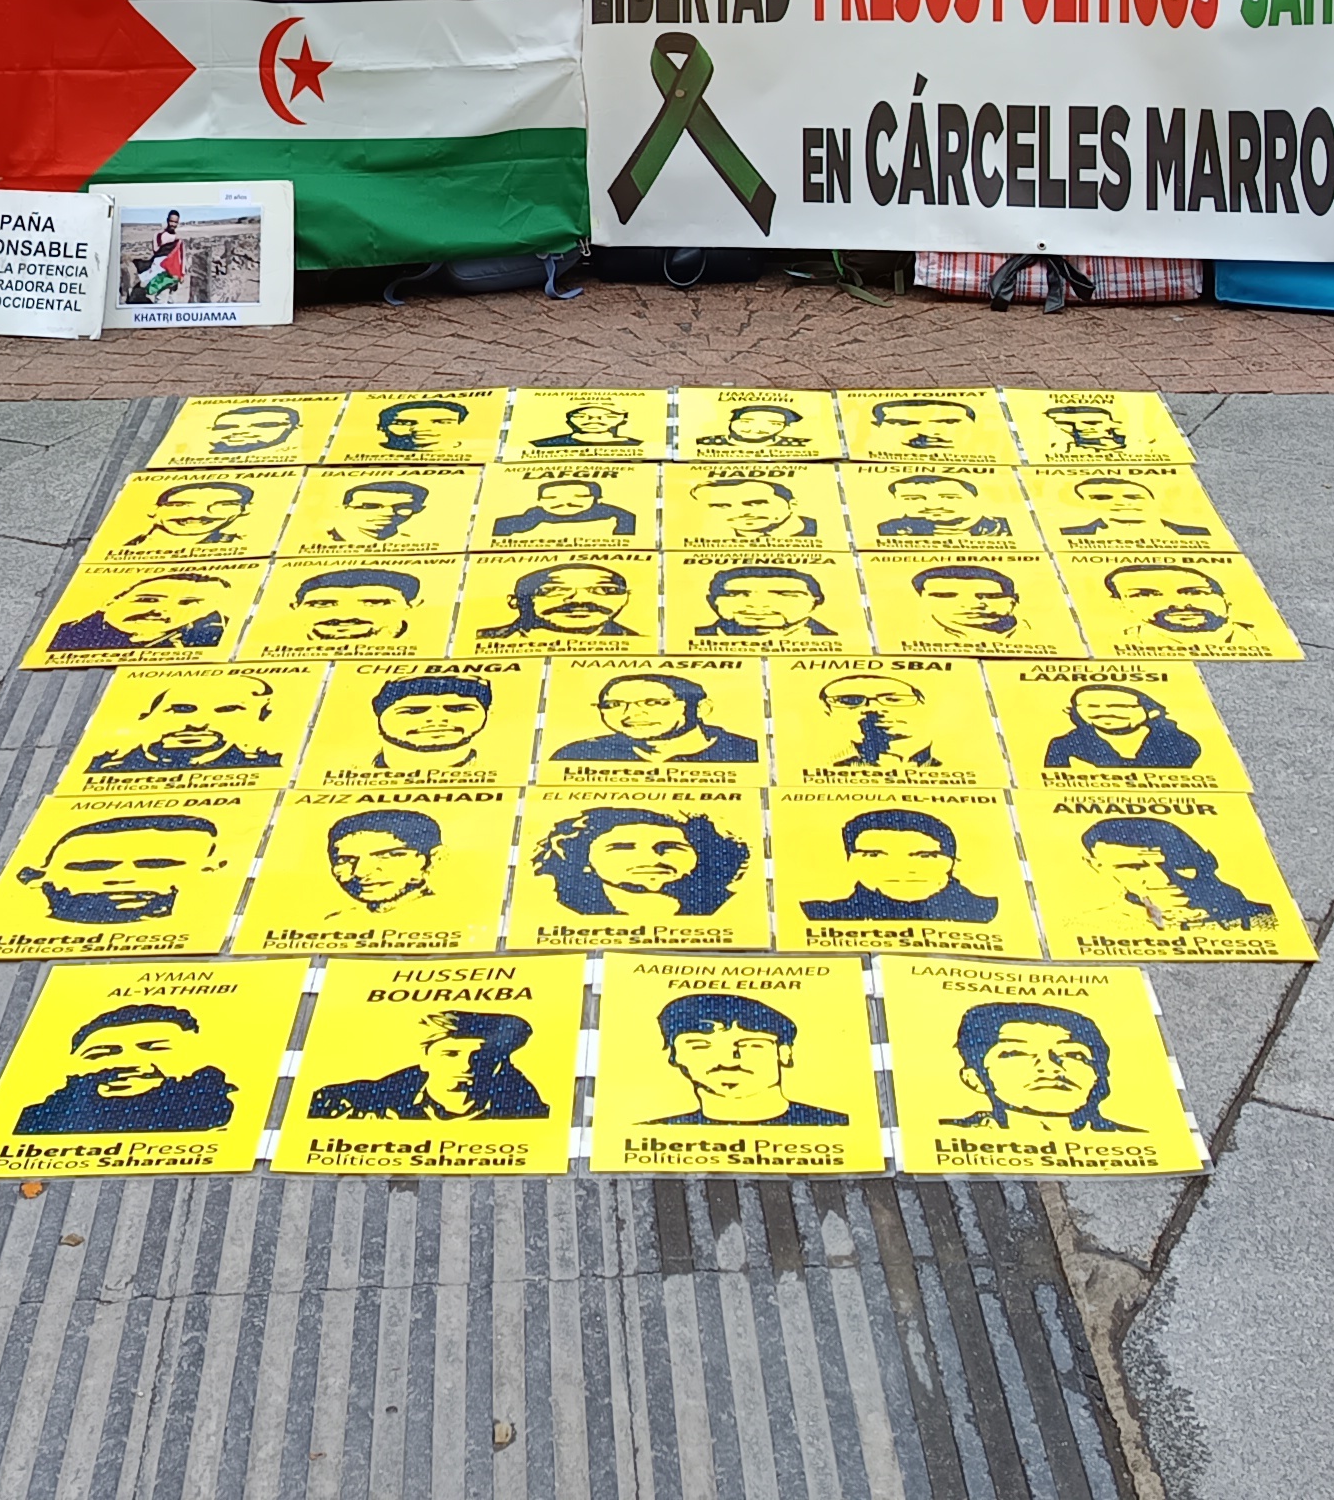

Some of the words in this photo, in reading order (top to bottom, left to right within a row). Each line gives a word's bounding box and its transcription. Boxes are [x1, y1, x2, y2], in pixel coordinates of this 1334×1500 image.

[803, 128, 851, 204] EN
[867, 72, 1130, 212] CÁRCELES
[18, 263, 88, 278] POTENCIA
[59, 283, 85, 295] DEL
[133, 312, 172, 323] KHATRI
[175, 310, 237, 323] BOUJAMAA
[1035, 467, 1122, 476] HASSAN
[1127, 467, 1178, 476] DAH
[476, 554, 560, 564] BRAHIM
[569, 554, 653, 562] ISMAILI
[356, 663, 418, 675] CHEJ
[425, 663, 520, 673] BANGA
[791, 660, 884, 670] AHMED
[891, 661, 953, 672] SBAI
[71, 799, 179, 810] MOHAMED
[182, 797, 242, 808] DADA
[294, 793, 354, 805] AZIZ
[357, 793, 502, 803] ALUAHADI
[1053, 803, 1218, 815] AMADOUR
[393, 968, 516, 982] HUSSEIN
[632, 963, 716, 976] AABIDIN
[721, 966, 830, 976] MOHAMED
[911, 966, 1022, 982] LAAROUSSI
[1028, 973, 1110, 985] BRAHIM
[136, 971, 214, 983] AYMAN
[107, 984, 238, 997] AL-YATHRIBI
[666, 979, 732, 990] FADEL
[736, 980, 802, 990] ELBAR
[942, 981, 1036, 995] ESSALEM
[1042, 986, 1090, 997] AILA
[367, 988, 533, 1002] BOURAKBA
[309, 1139, 431, 1152] Libertad
[439, 1140, 529, 1154] Presos
[935, 1139, 1057, 1154] Libertad
[1065, 1142, 1156, 1156] Presos
[307, 1153, 402, 1166] Políticos
[410, 1155, 526, 1166] Saharauis
[937, 1154, 1033, 1166] Políticos
[1041, 1156, 1158, 1167] Saharauis
